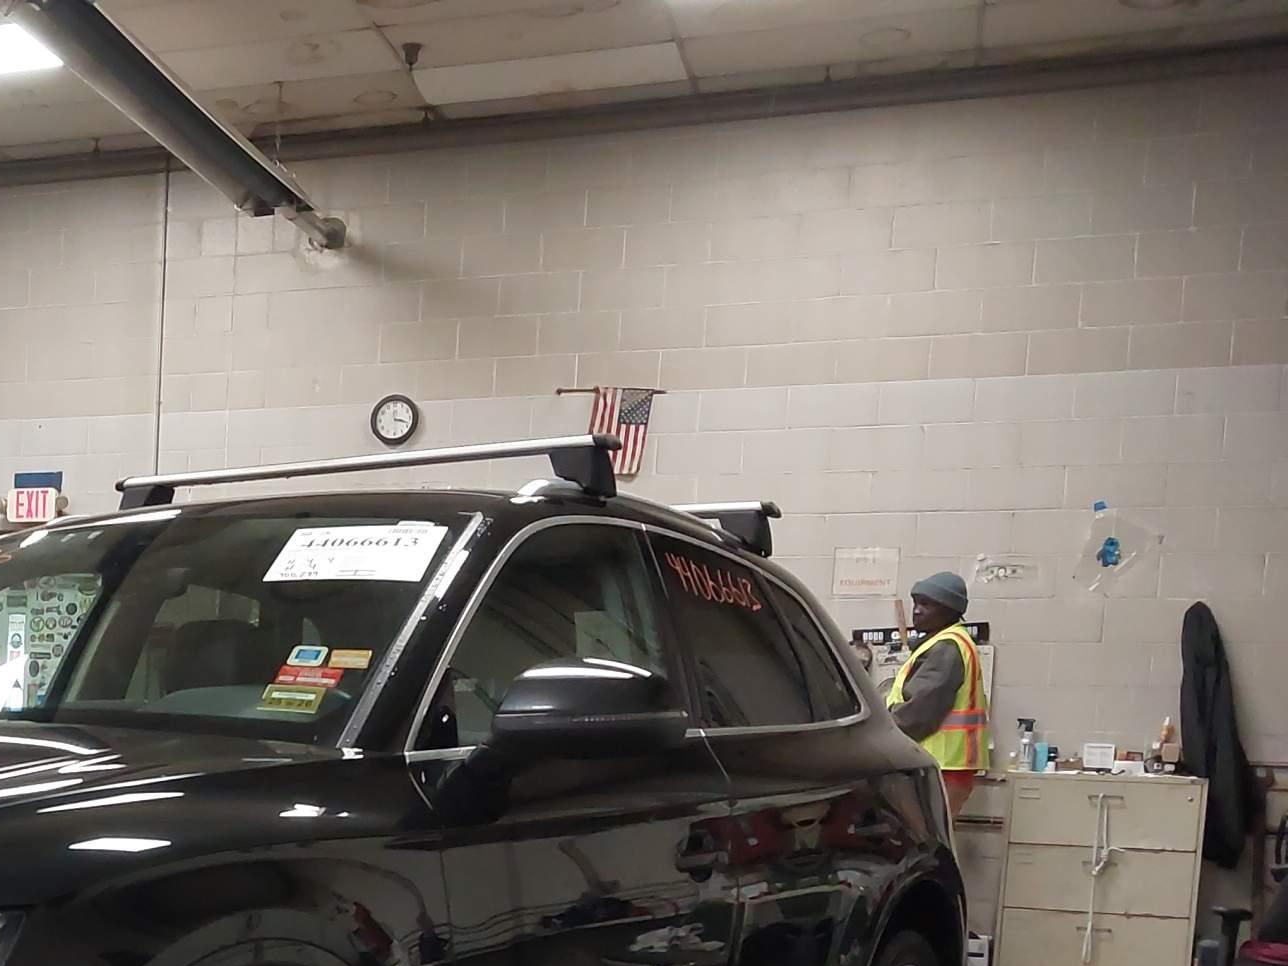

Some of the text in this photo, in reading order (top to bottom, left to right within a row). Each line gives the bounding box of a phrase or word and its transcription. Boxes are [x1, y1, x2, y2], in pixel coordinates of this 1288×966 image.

[15, 490, 49, 519] EXIT
[301, 537, 420, 548] 44066613
[664, 552, 762, 611] 44066613
